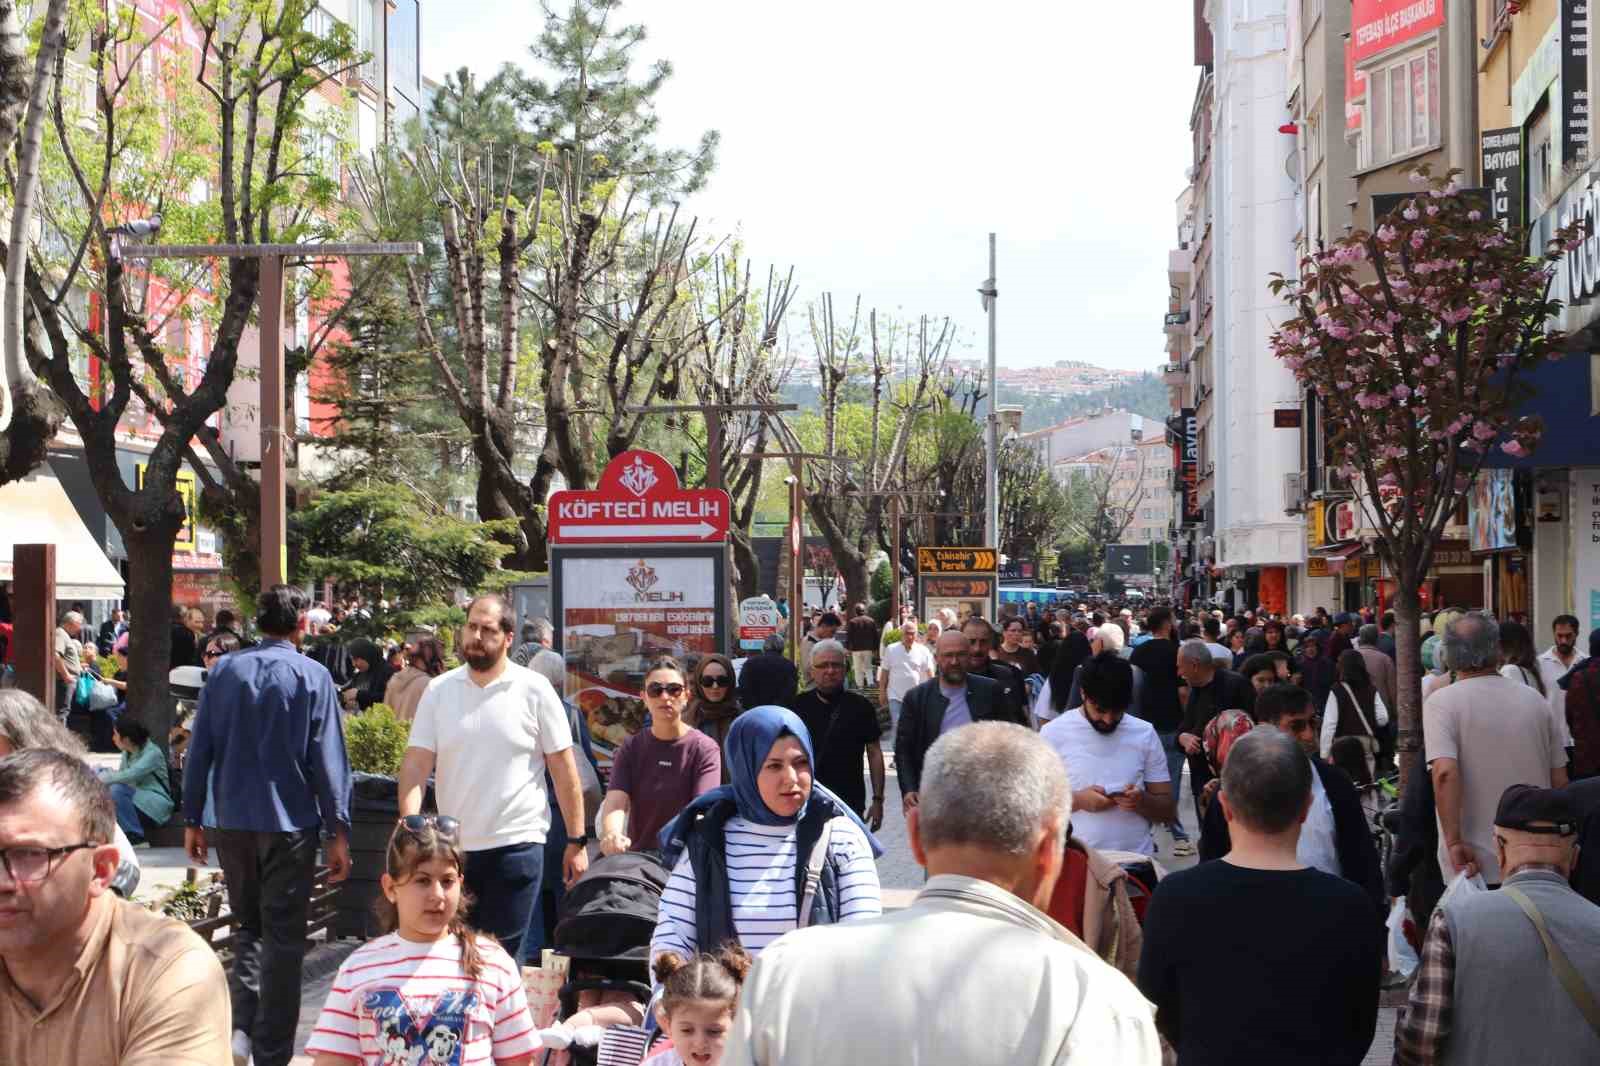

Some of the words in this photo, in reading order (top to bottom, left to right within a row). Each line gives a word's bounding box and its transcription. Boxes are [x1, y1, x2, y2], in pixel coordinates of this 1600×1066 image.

[1484, 150, 1520, 170] BAYAN
[1187, 416, 1198, 461] avm
[559, 499, 646, 518] KÖFTECİ
[653, 498, 719, 518] MELİH
